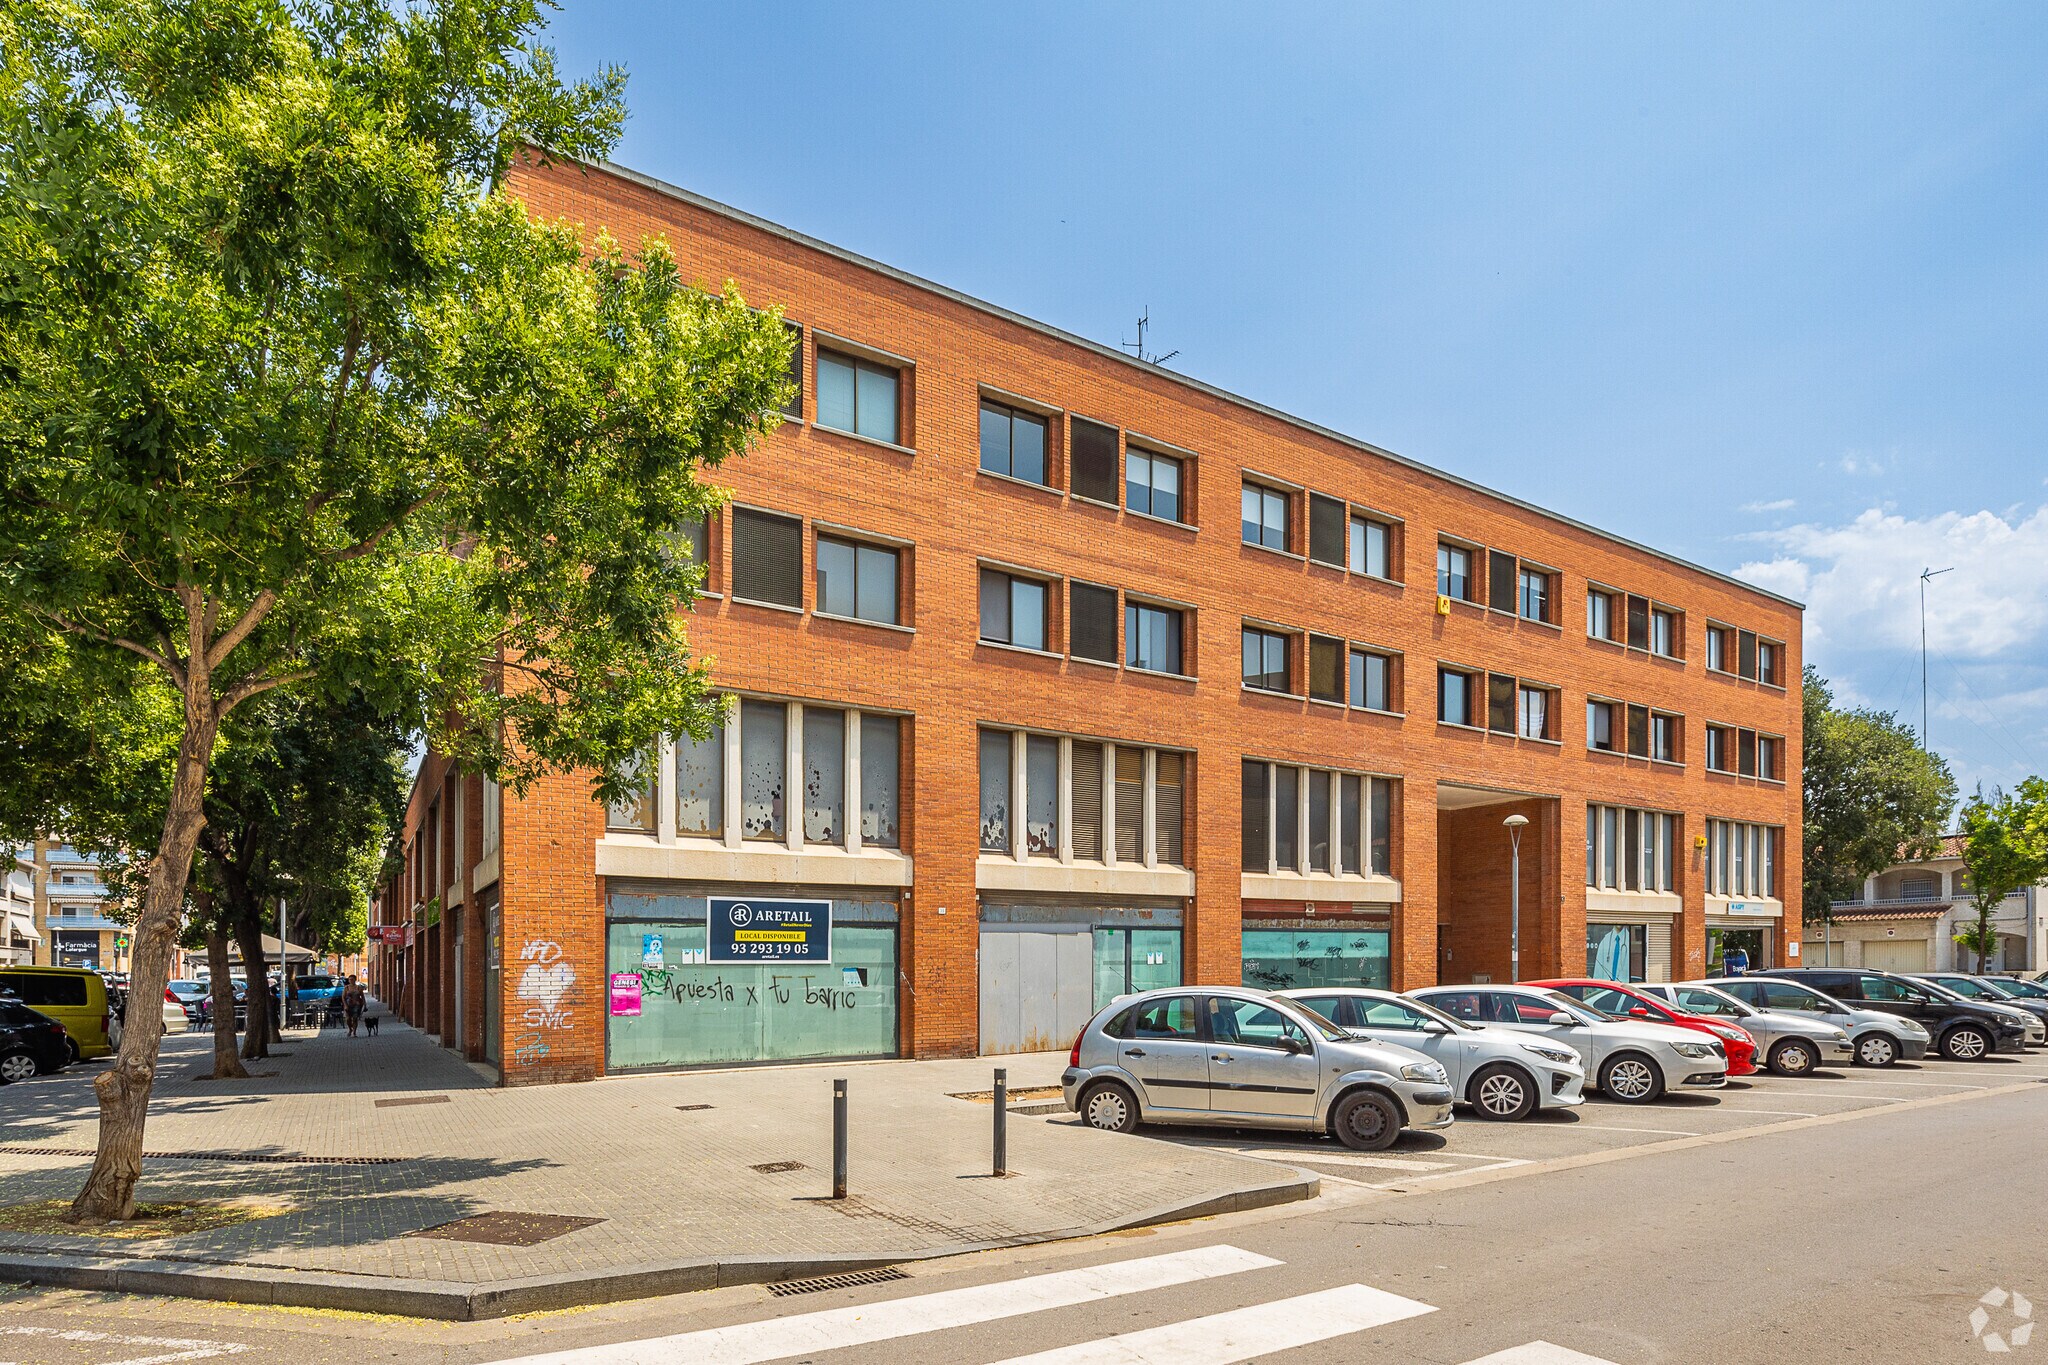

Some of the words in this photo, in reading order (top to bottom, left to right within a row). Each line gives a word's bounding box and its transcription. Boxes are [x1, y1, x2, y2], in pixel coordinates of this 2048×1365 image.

[755, 910, 812, 922] ARETAIL
[740, 932, 761, 940] LOCAL
[763, 932, 801, 940] DISPONIBLE
[731, 943, 747, 954] 93
[750, 943, 773, 954] 293
[776, 943, 791, 954] 19
[794, 943, 809, 954] 05
[663, 975, 734, 1003] Apuesta
